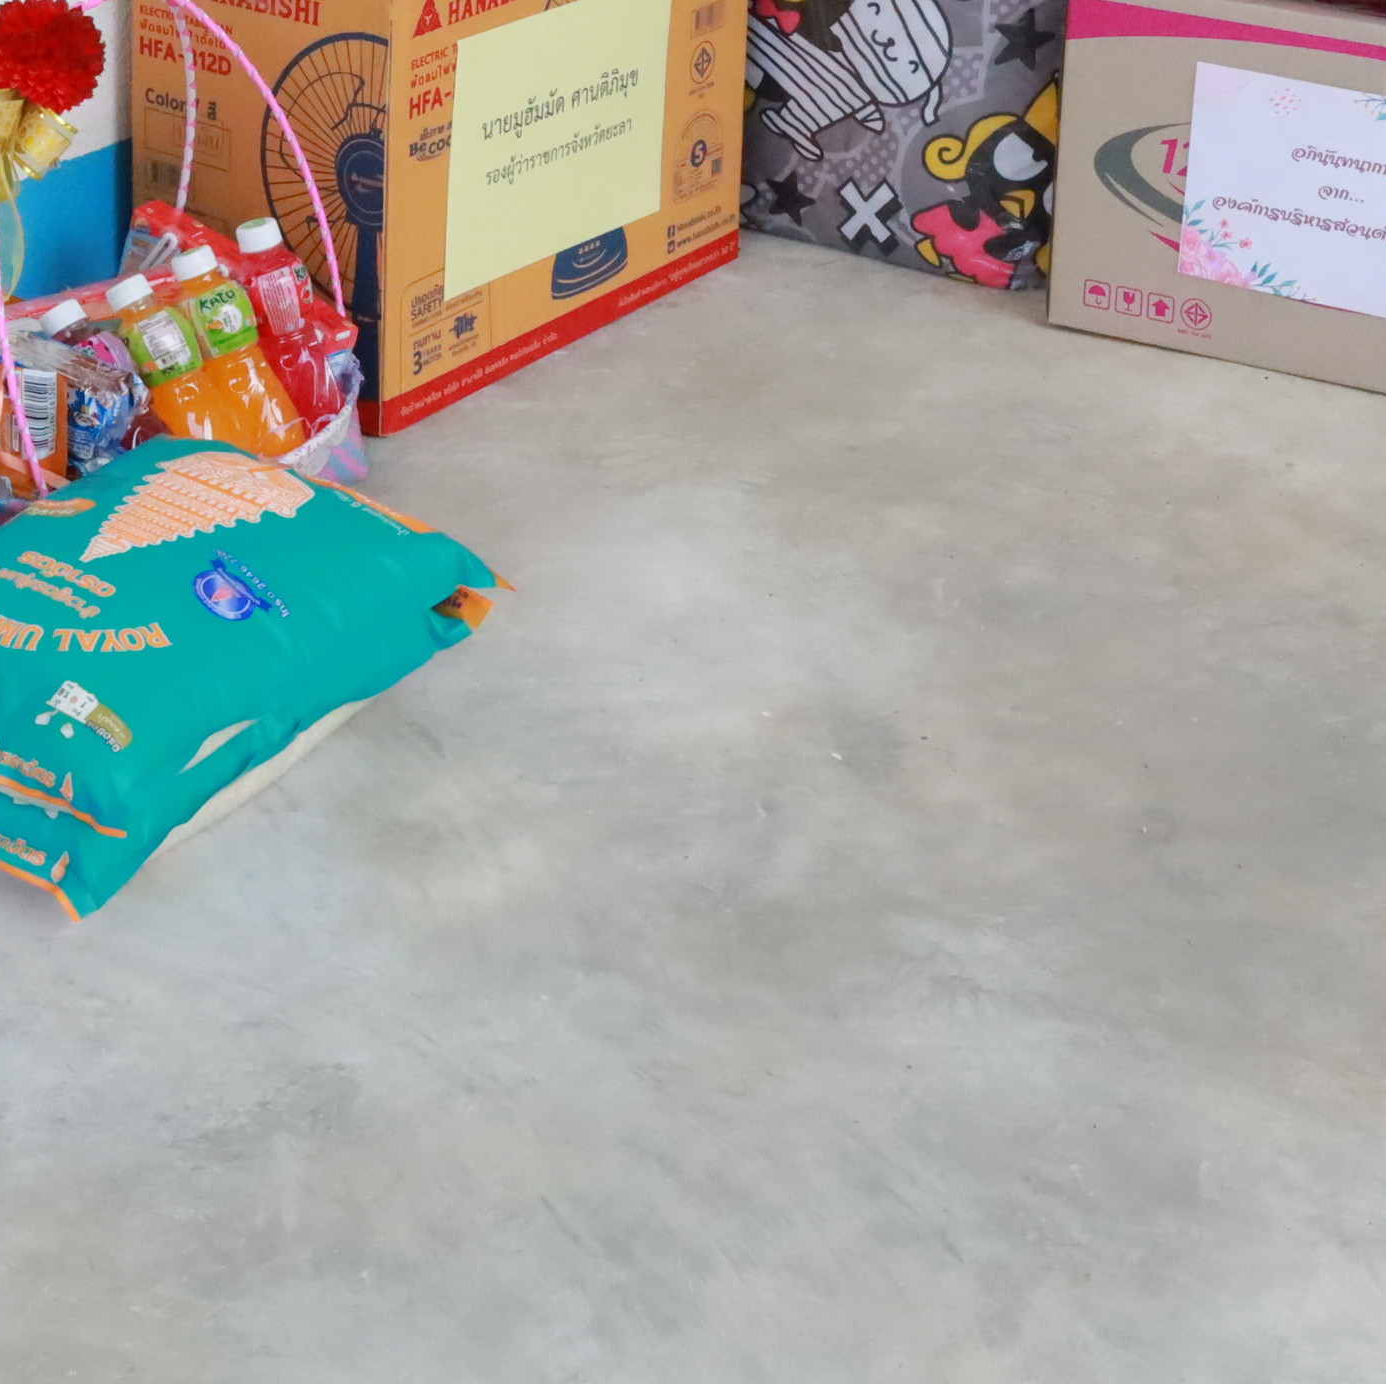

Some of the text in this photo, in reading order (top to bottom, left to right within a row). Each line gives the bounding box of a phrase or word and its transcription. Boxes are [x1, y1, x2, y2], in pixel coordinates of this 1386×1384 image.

[139, 4, 177, 22] ELECTRI
[410, 46, 449, 72] ELECTRIC
[409, 86, 454, 120] HFA-
[481, 65, 640, 141] นายมูฮัมมัด ศานติภิมุข
[484, 116, 634, 187] รองผู้ว่าราชการจังหวัดยะลา
[413, 350, 424, 376] 3
[51, 620, 174, 653] ROYAL
